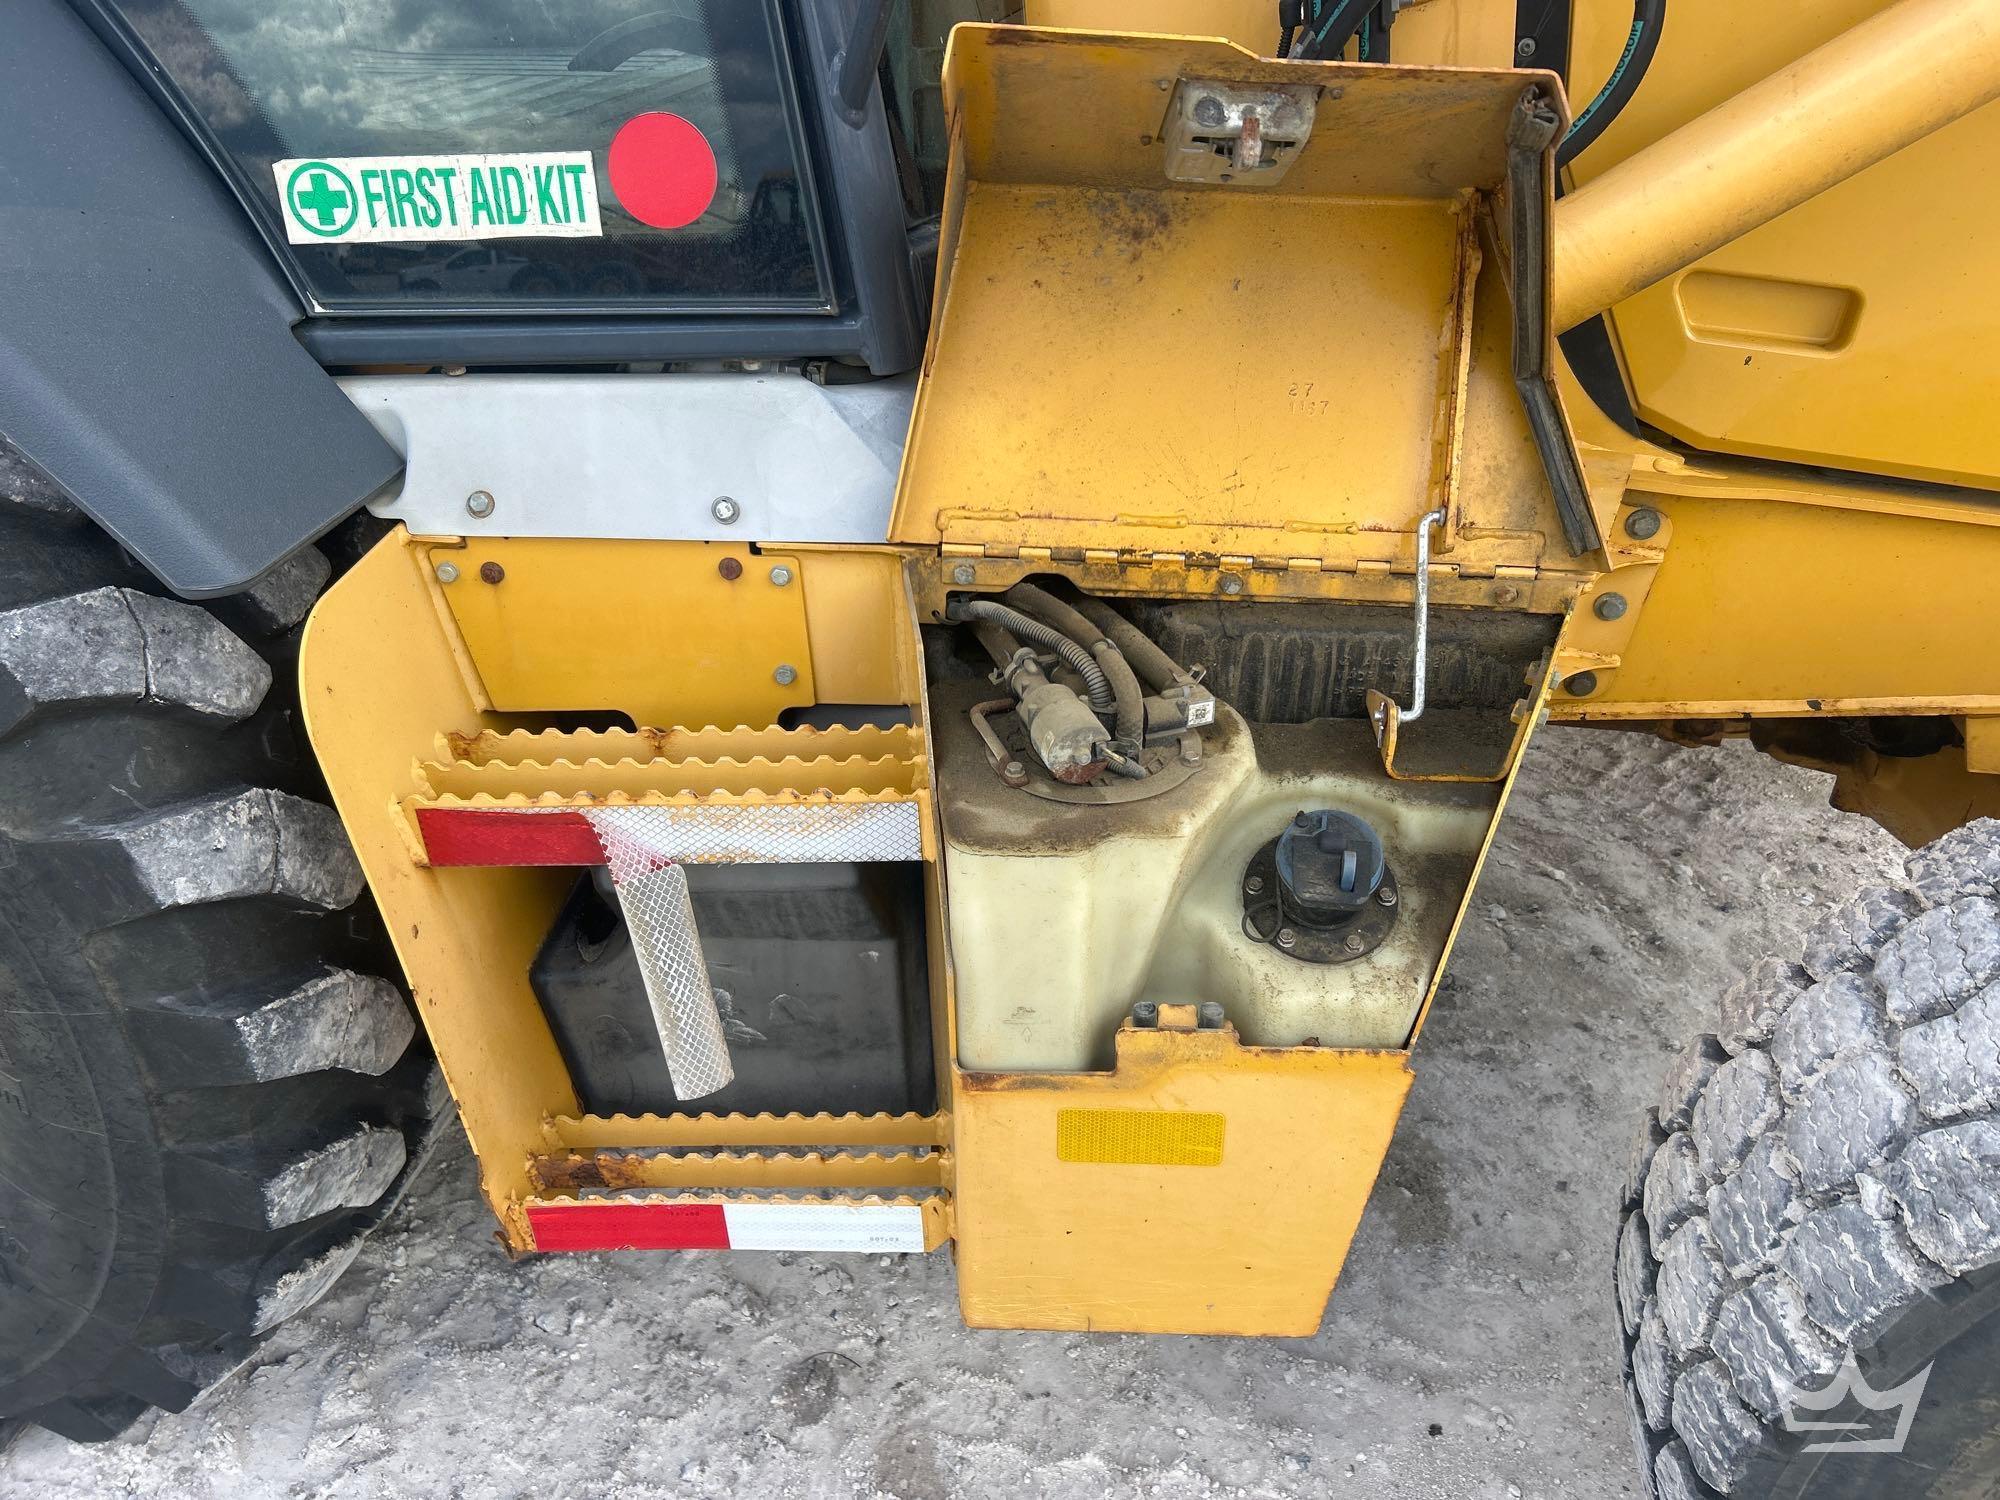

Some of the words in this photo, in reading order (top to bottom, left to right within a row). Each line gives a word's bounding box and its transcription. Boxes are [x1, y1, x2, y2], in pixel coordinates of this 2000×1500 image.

[360, 167, 457, 228] FIRST
[471, 166, 527, 226] AID
[534, 164, 586, 225] KIT
